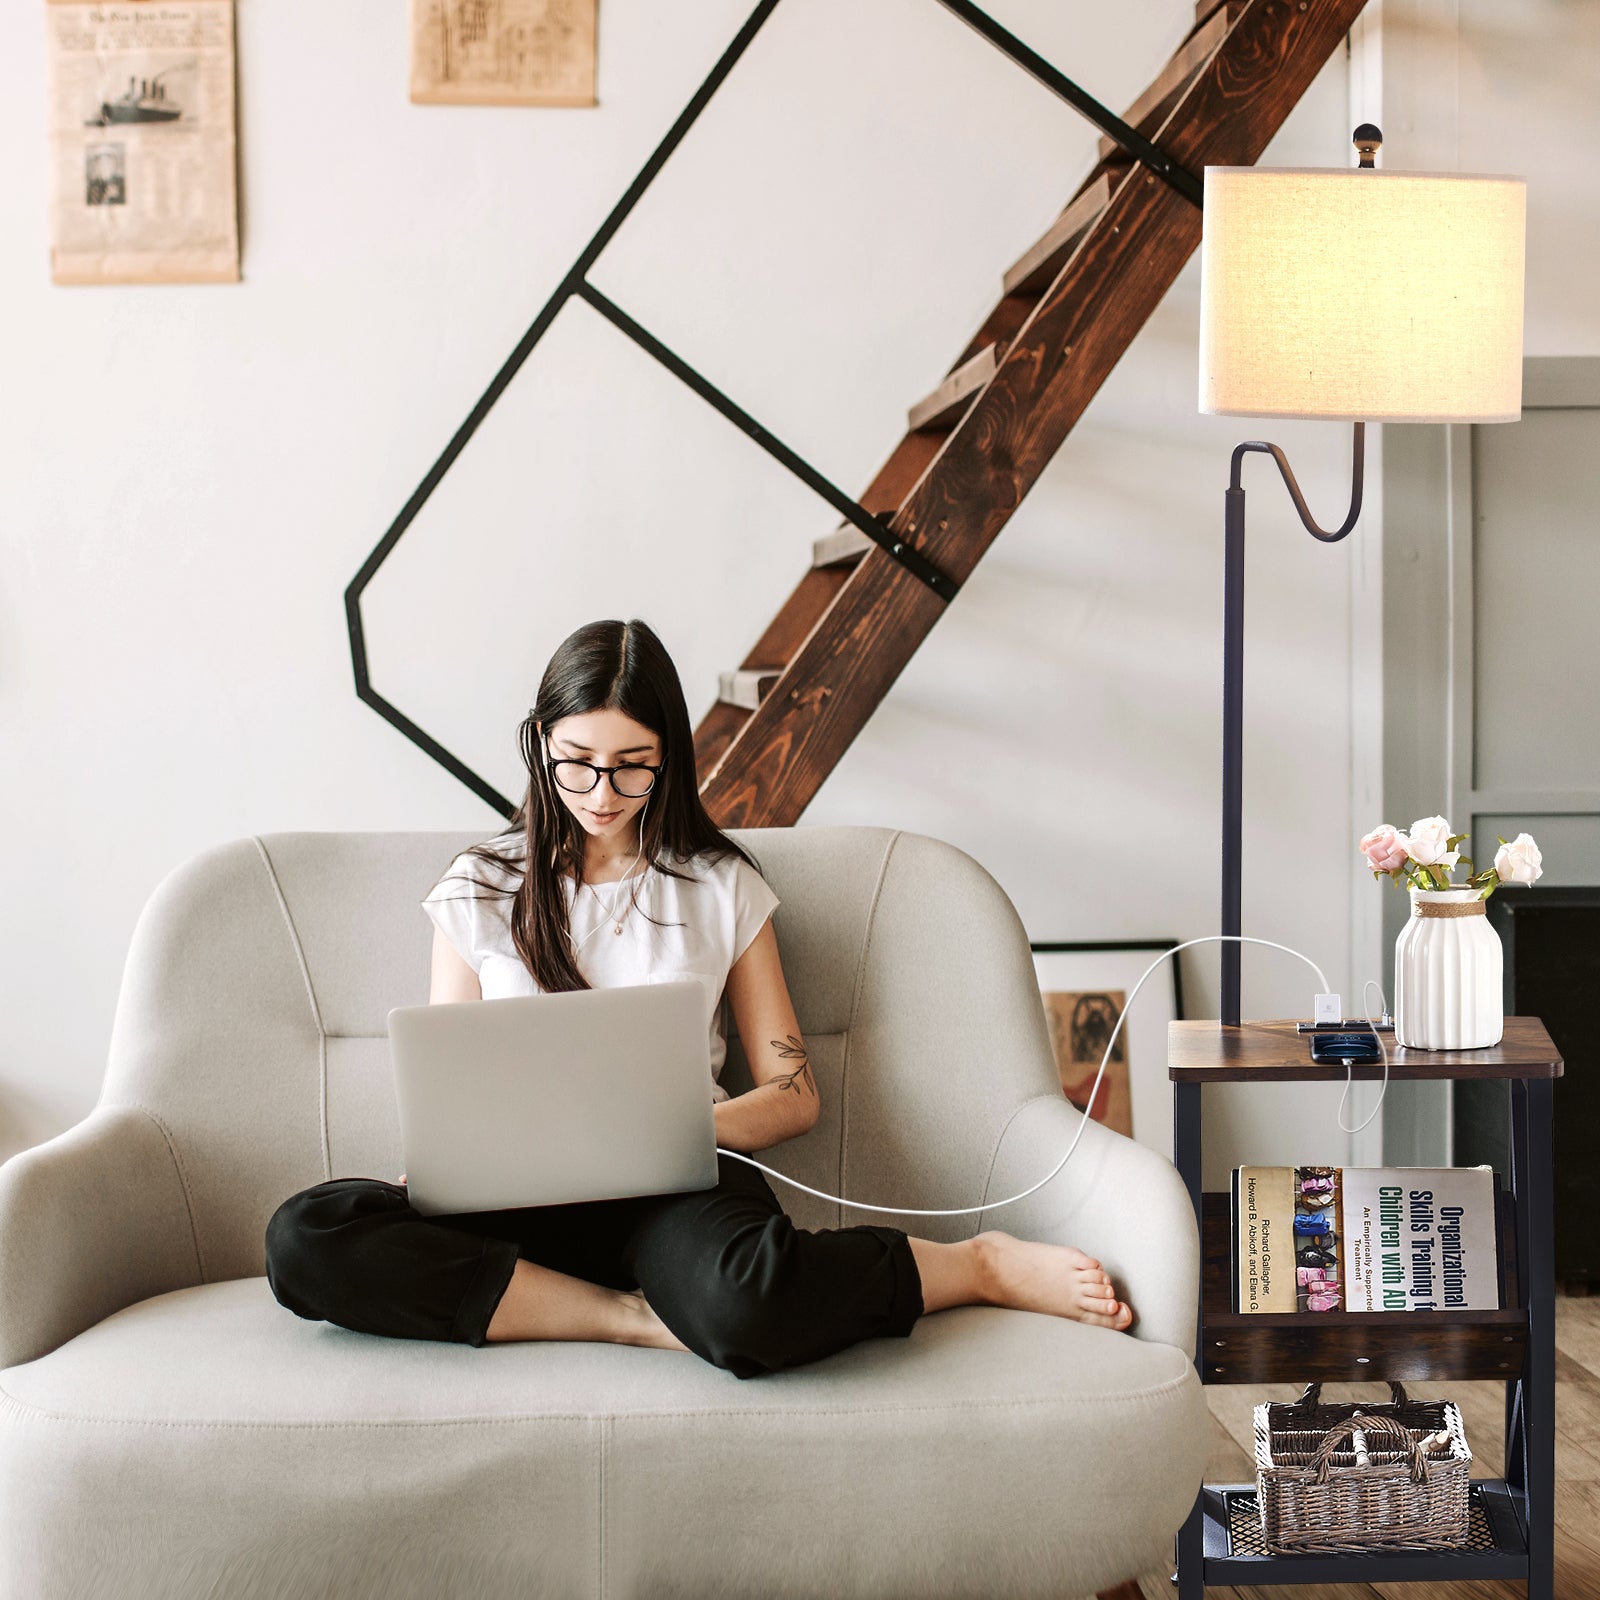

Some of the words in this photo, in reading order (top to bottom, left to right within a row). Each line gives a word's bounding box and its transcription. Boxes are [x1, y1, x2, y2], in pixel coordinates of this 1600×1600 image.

[1248, 1178, 1256, 1211] Howard
[1410, 1190, 1433, 1232] Skills
[1249, 1213, 1256, 1222] B.
[1363, 1207, 1371, 1218] An
[1379, 1186, 1403, 1248] Children
[1248, 1224, 1257, 1257] Abikoff,
[1262, 1219, 1270, 1252] Richard
[1364, 1221, 1373, 1266] Empirically
[1354, 1239, 1362, 1281] Treatment
[1382, 1253, 1405, 1284] with
[1409, 1238, 1436, 1296] Training
[1438, 1206, 1468, 1308] Organizational
[1250, 1278, 1258, 1300] Elana
[1261, 1254, 1270, 1296] Gallagher,
[1365, 1269, 1374, 1311] Supported
[1251, 1302, 1258, 1312] G.
[1382, 1289, 1406, 1312] AD
